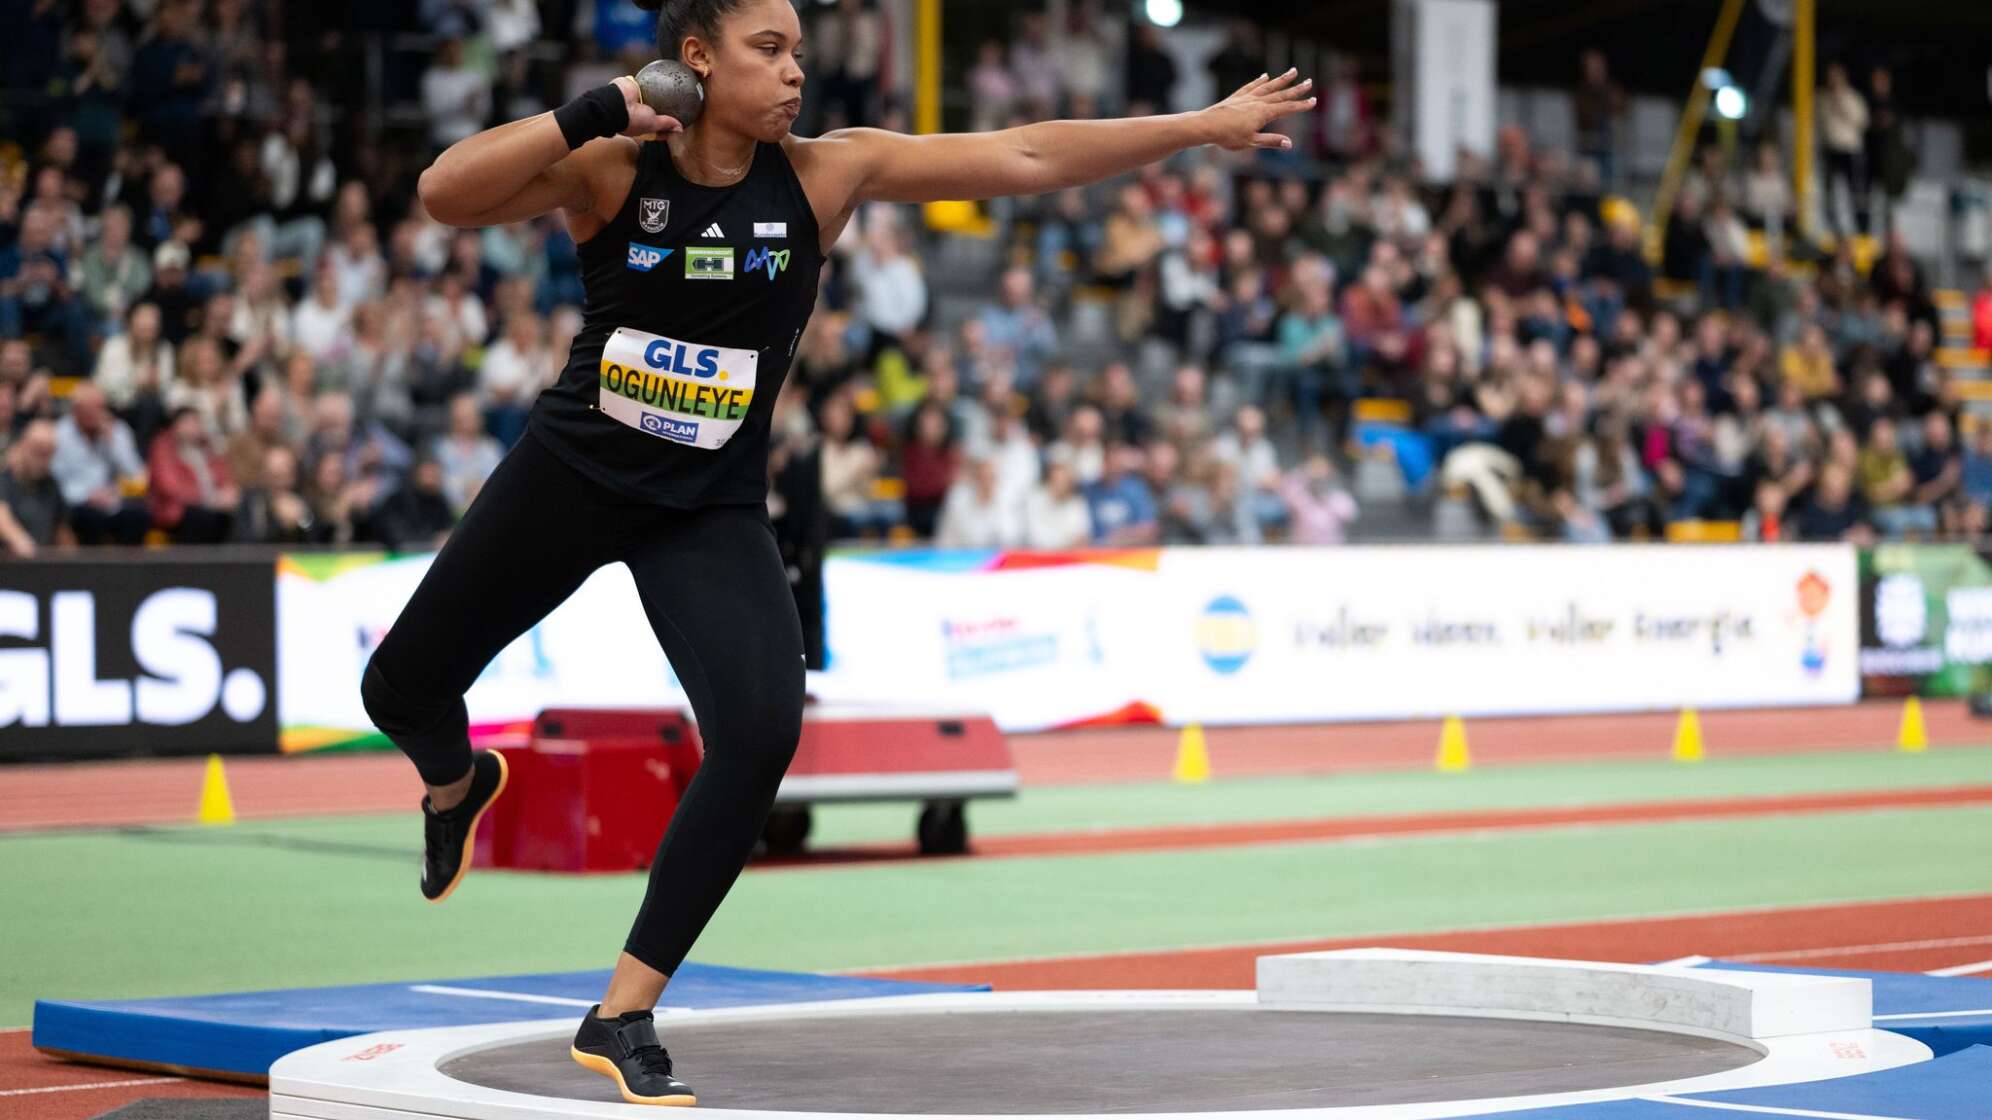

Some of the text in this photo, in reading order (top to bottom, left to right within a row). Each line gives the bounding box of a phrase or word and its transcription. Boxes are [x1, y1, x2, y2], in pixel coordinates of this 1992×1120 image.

[628, 247, 660, 268] SAP
[644, 339, 729, 381] GLS.
[606, 364, 743, 419] OGUNLEYE
[663, 421, 696, 436] PLAN
